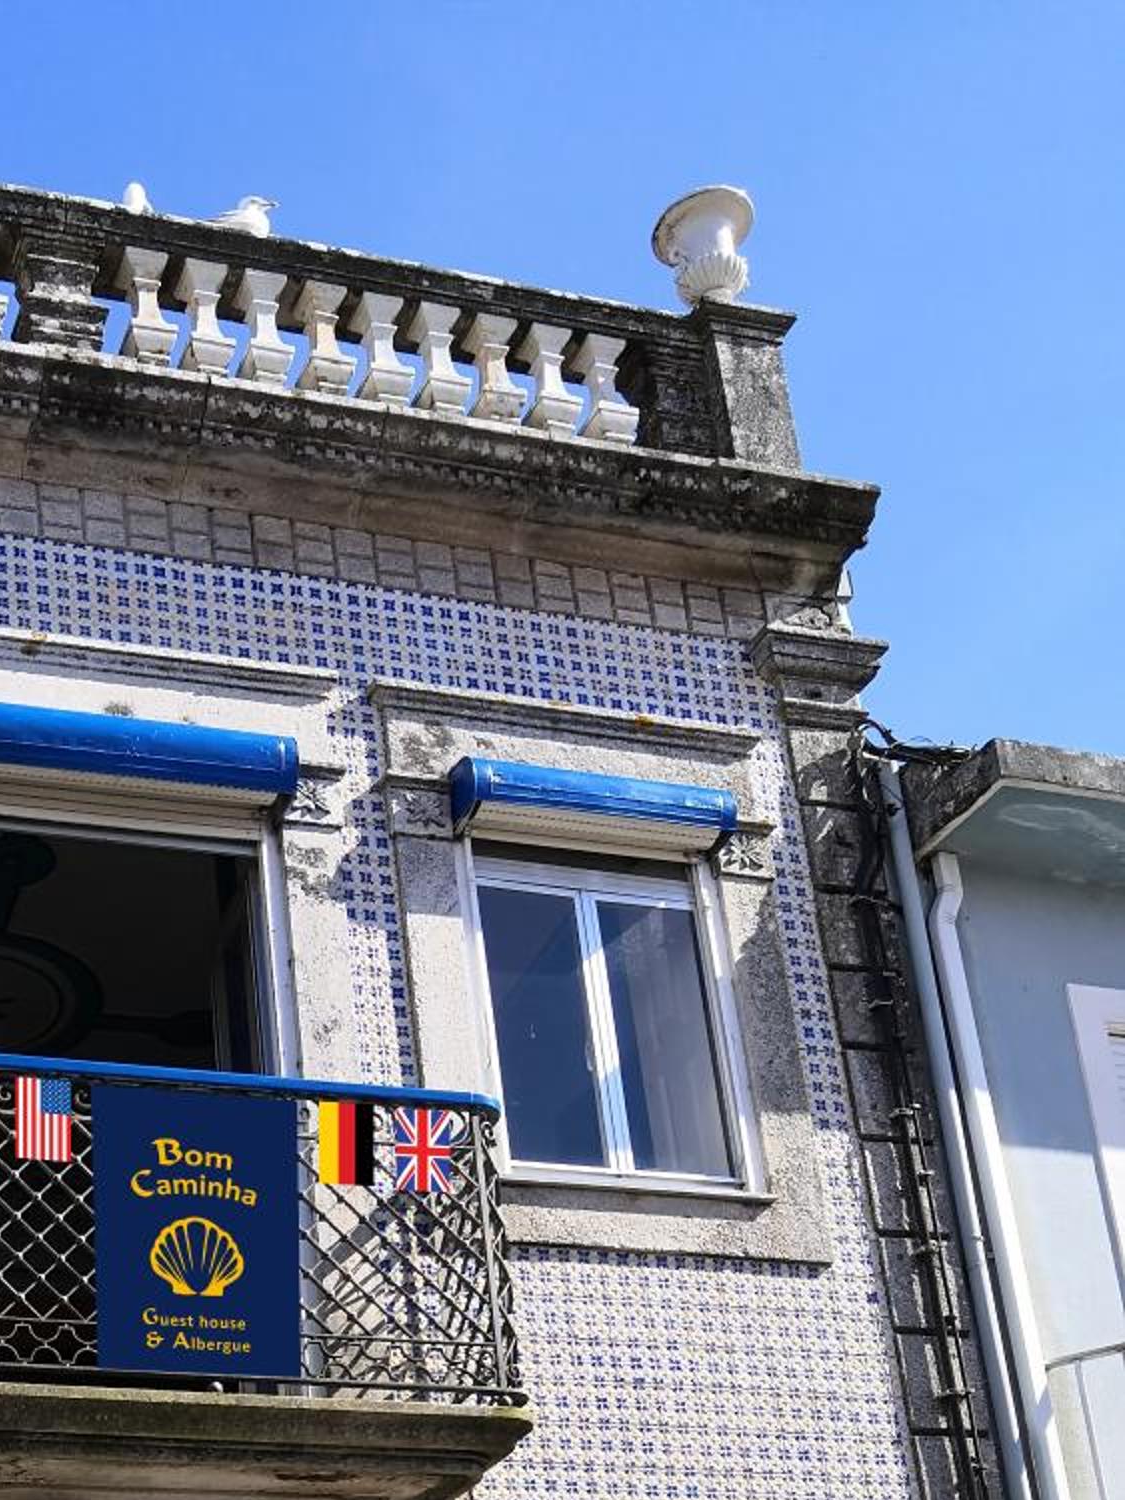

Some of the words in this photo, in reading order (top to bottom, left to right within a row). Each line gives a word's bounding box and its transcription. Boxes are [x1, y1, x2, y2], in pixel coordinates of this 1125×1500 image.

[151, 1138, 232, 1170] Bom
[130, 1169, 257, 1206] Caminha
[142, 1308, 193, 1326] Guest
[199, 1316, 246, 1331] house
[146, 1332, 163, 1348] &
[172, 1331, 251, 1355] Albergue
